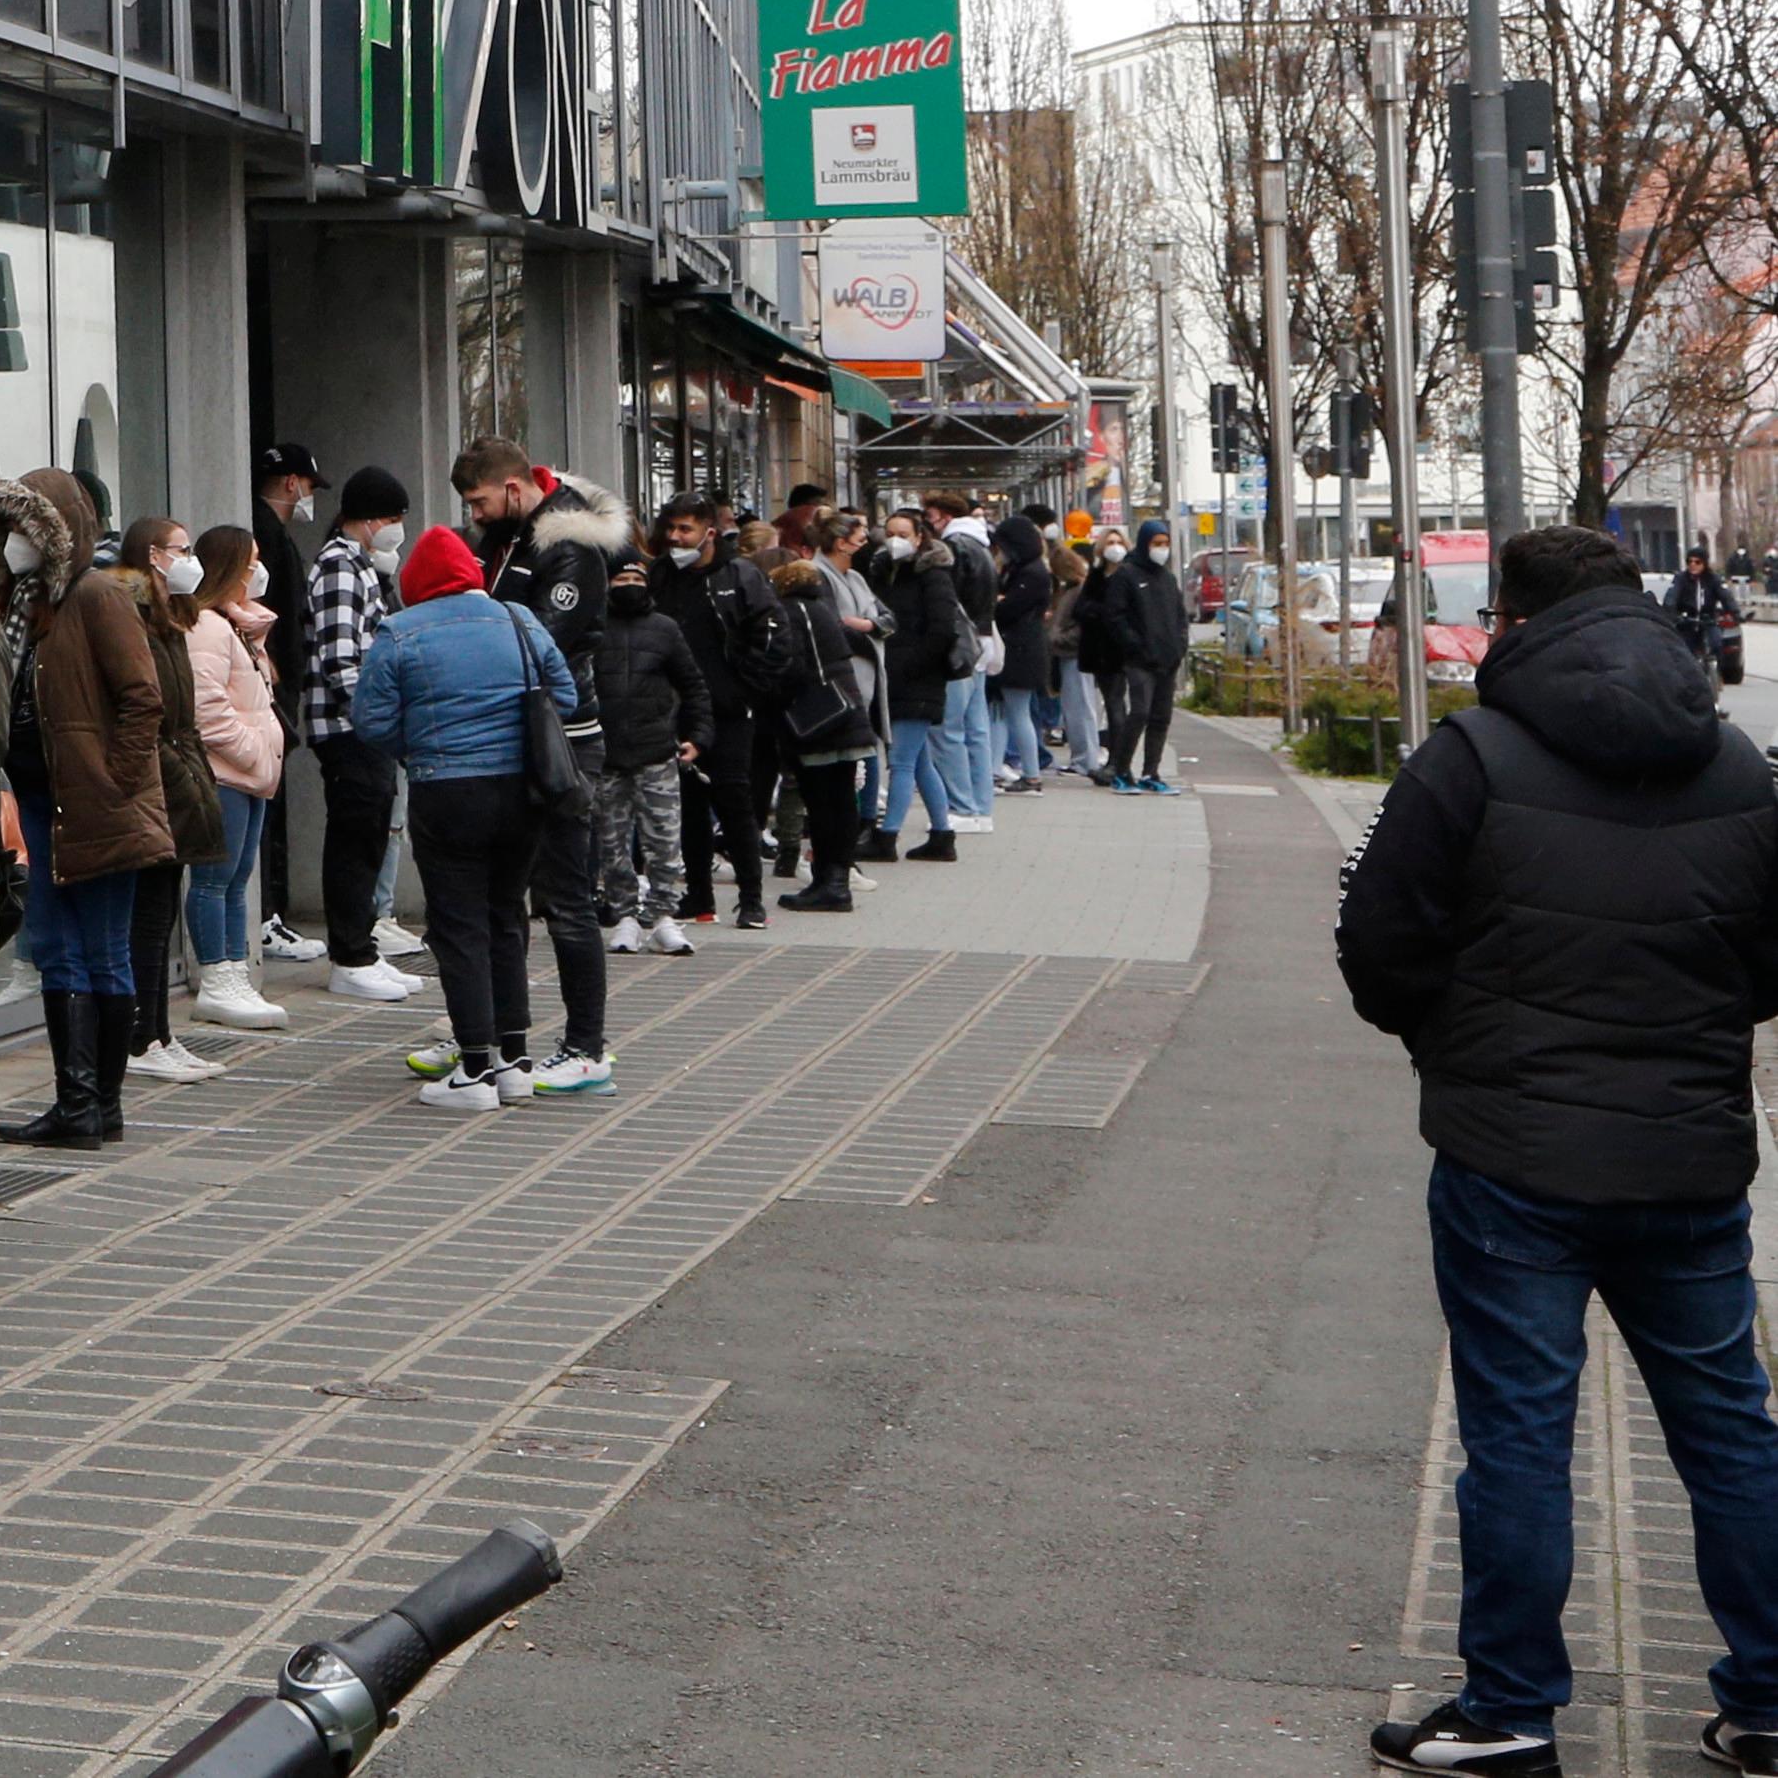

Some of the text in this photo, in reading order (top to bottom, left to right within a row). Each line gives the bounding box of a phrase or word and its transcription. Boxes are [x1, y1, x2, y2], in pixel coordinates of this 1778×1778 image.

[770, 32, 953, 99] Fiamma
[832, 158, 899, 169] Neumarkter
[821, 169, 911, 184] Lammsbräu
[833, 288, 908, 308] WALB
[556, 586, 574, 606] 67
